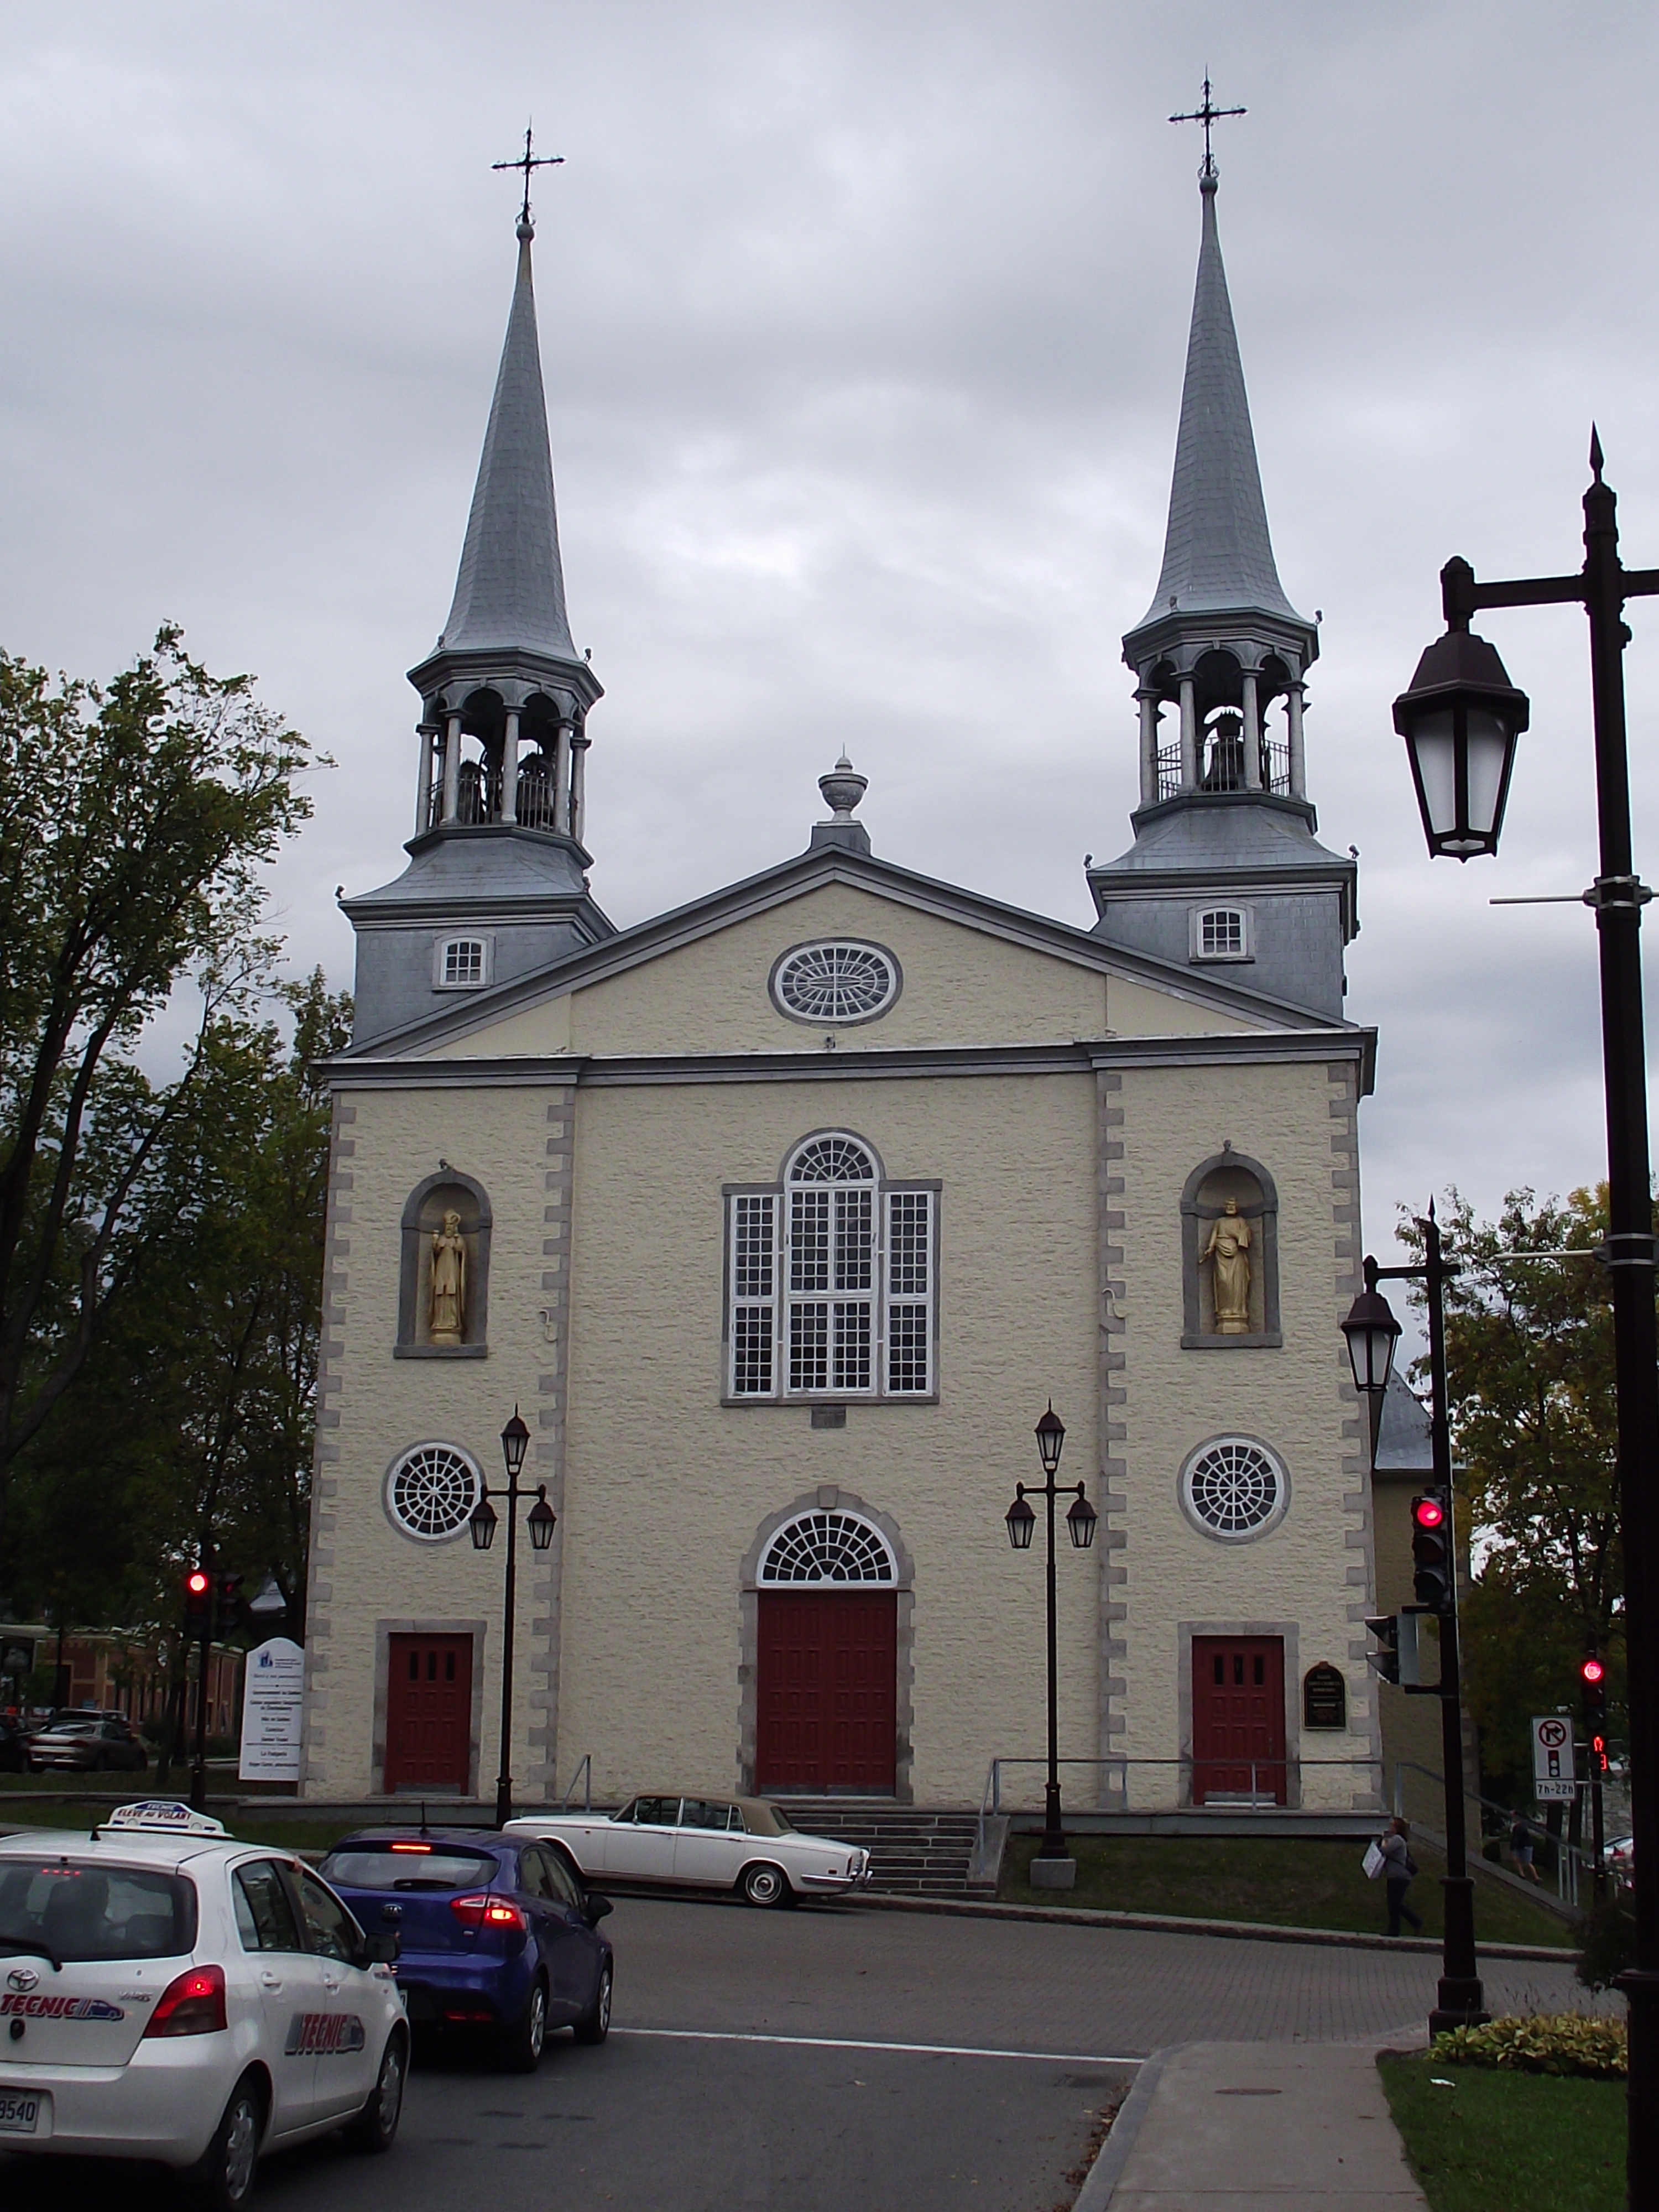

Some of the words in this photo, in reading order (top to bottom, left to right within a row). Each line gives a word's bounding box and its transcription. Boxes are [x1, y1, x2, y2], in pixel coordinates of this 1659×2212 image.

[1538, 1784, 1573, 1794] 7h-22h
[157, 1810, 192, 1820] VOLANT
[0, 1994, 81, 2016] TECNIC
[299, 2013, 348, 2047] TECNIC
